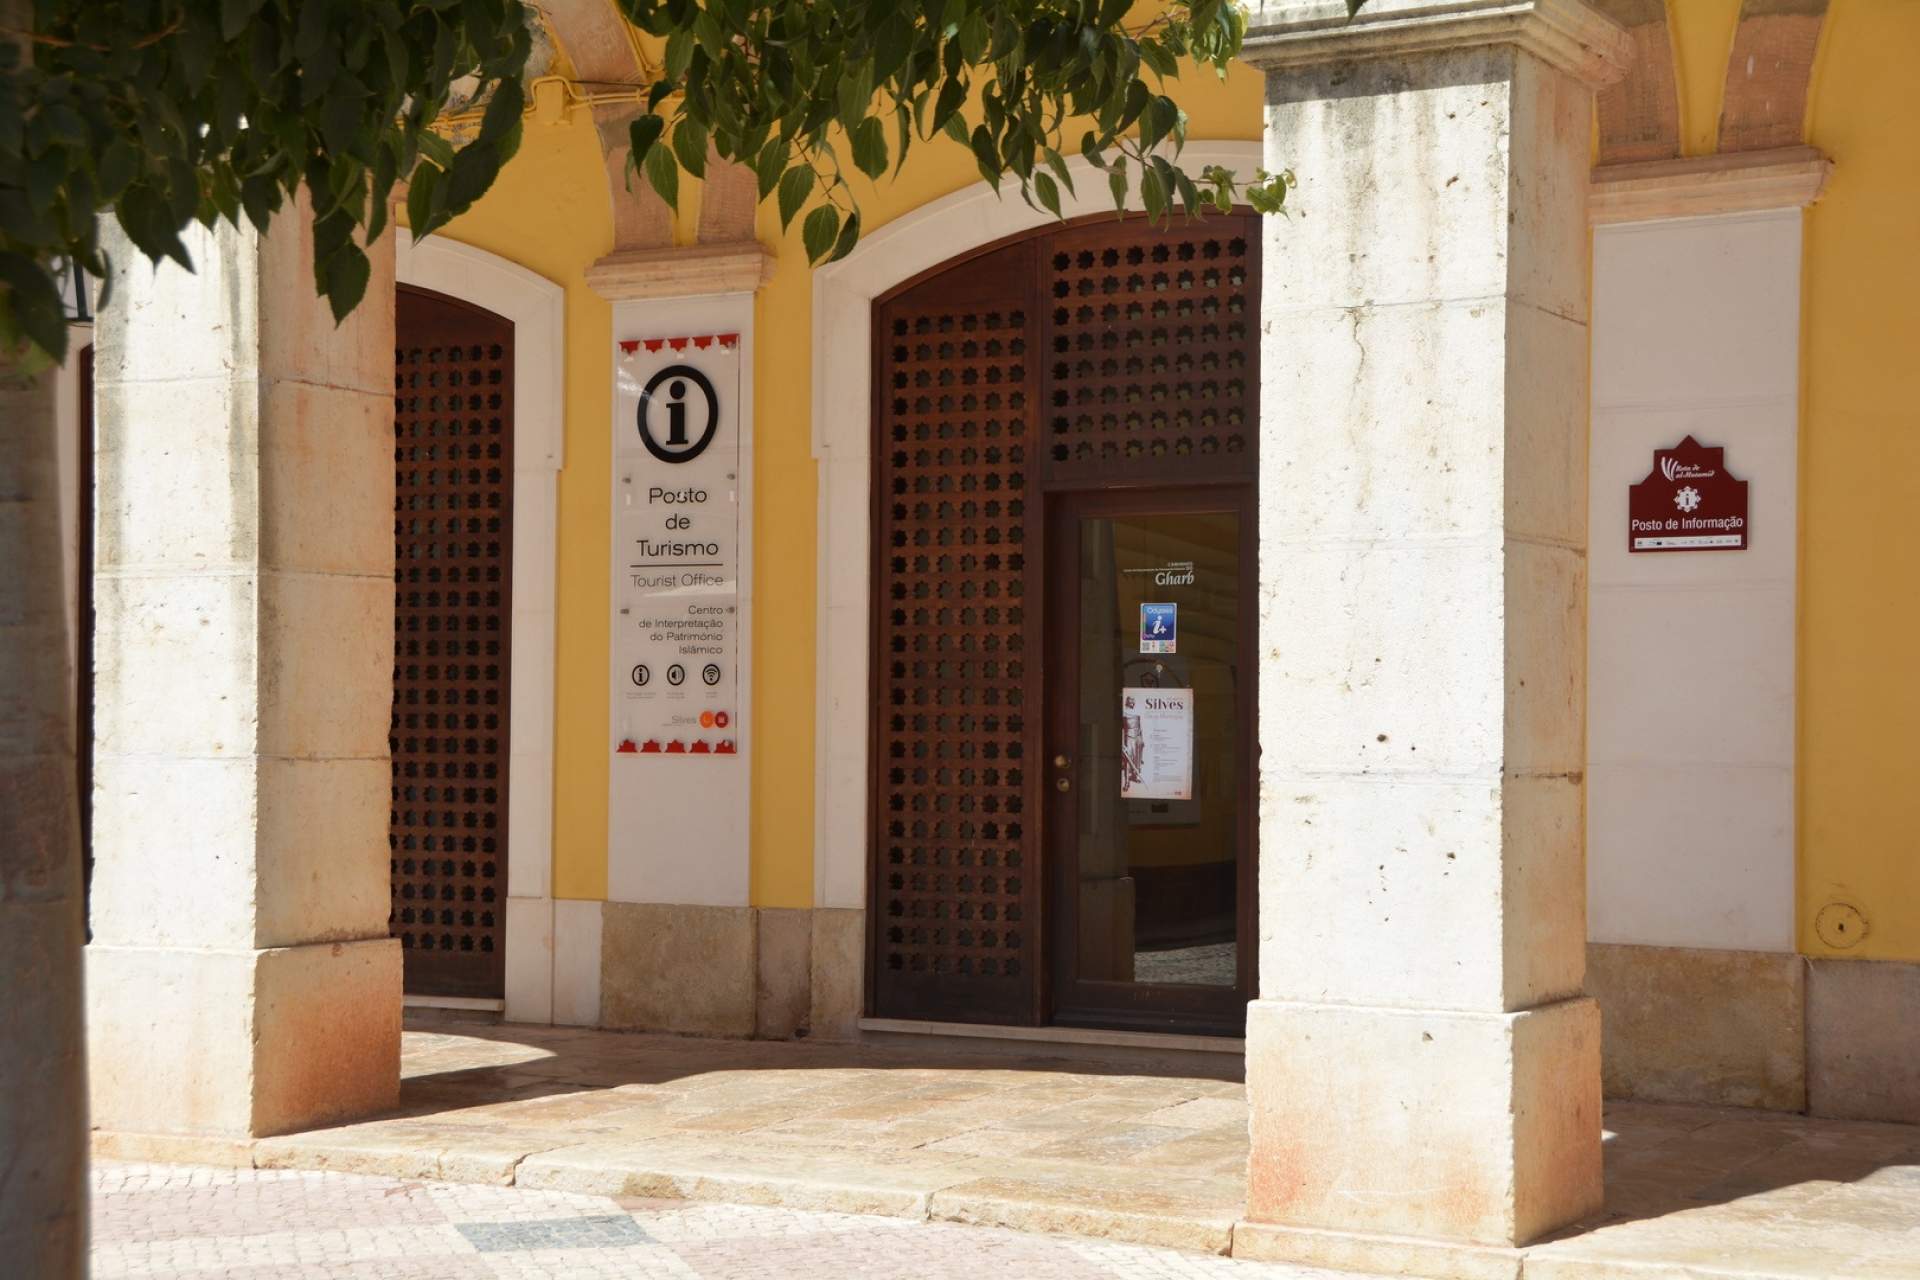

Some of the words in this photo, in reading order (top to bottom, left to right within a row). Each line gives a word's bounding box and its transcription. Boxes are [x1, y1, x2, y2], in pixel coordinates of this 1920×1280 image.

[649, 487, 708, 504] Posto
[665, 513, 691, 530] de
[1632, 519, 1662, 531] Posto
[1665, 518, 1679, 530] de
[1682, 516, 1743, 531] Informação
[636, 539, 719, 557] Turismo
[630, 574, 677, 588] Tourist
[681, 573, 724, 587] Office
[1155, 571, 1195, 586] Gharb
[688, 605, 724, 615] Centro
[639, 618, 652, 629] de
[655, 618, 723, 630] Interpretação
[650, 632, 663, 641] do
[666, 631, 723, 641] Património
[679, 644, 723, 655] Islâmico
[1145, 698, 1184, 710] Silves
